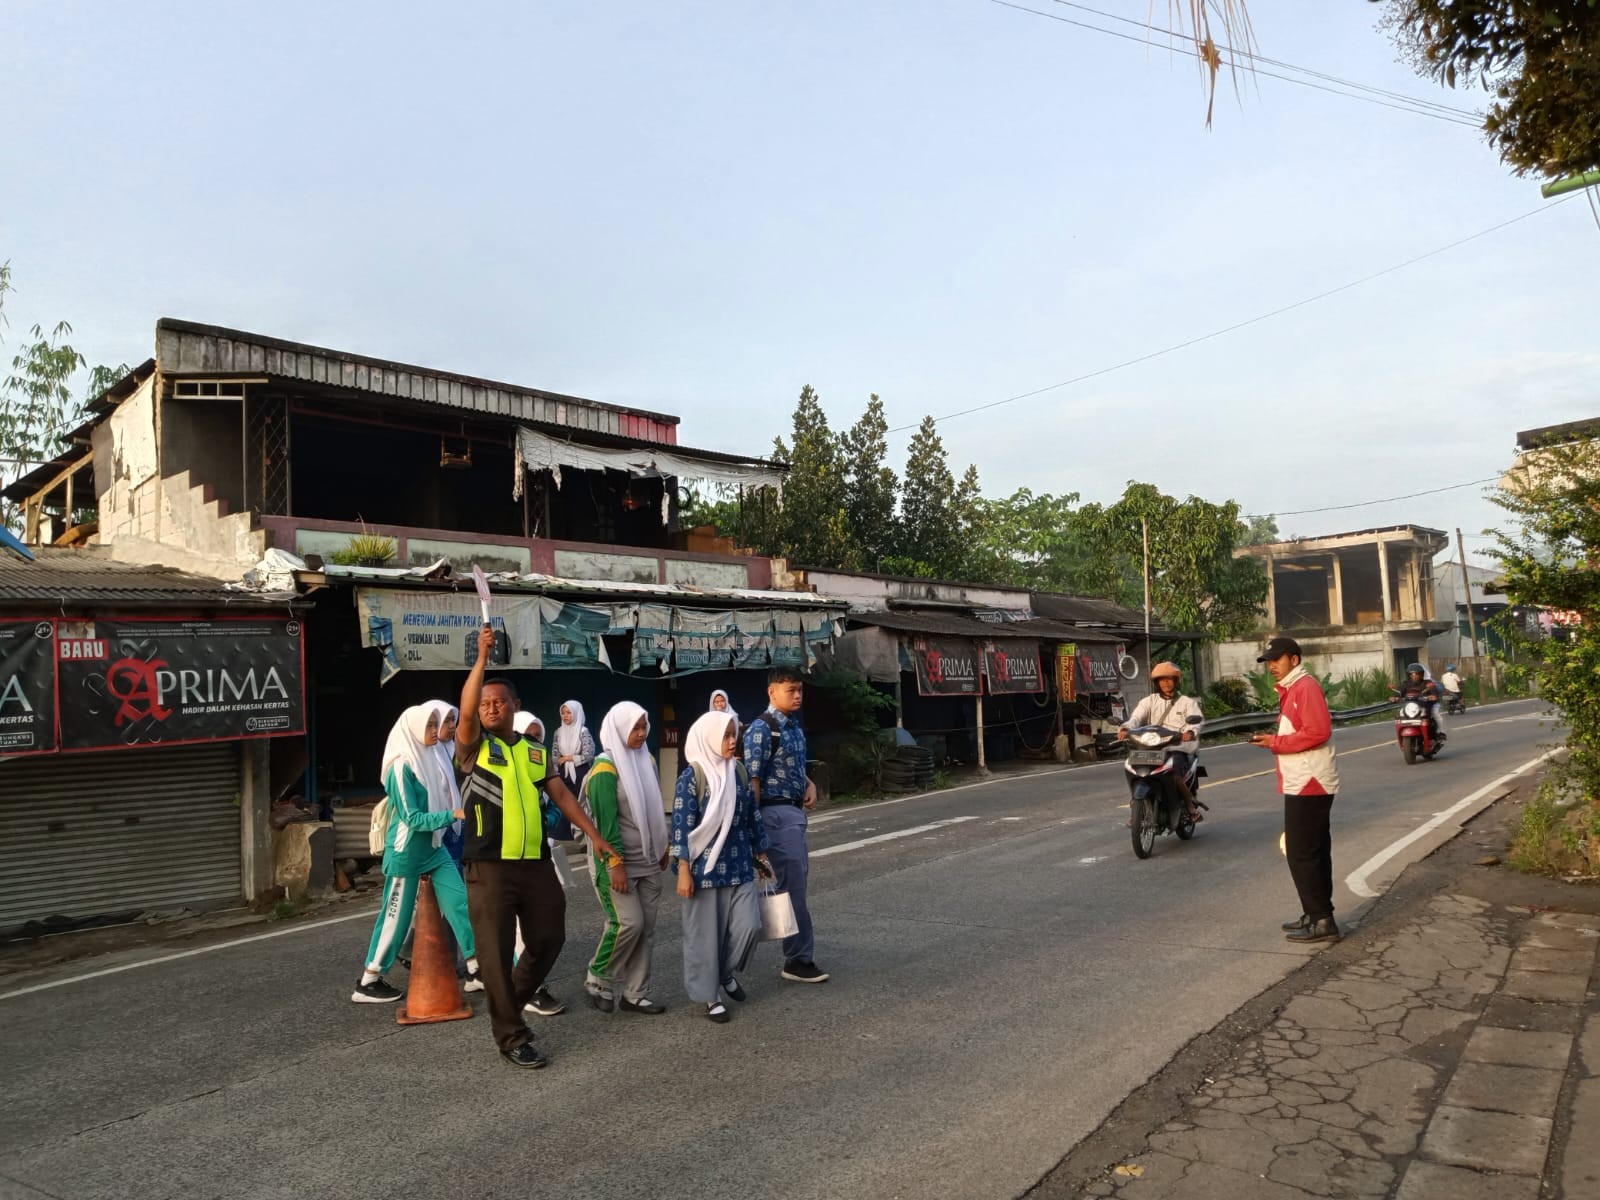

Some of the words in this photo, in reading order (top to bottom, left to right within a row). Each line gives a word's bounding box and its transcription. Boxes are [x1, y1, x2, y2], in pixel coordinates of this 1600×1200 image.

[403, 613, 436, 626] MENERIMA
[437, 614, 462, 628] JAHITAN
[463, 615, 476, 628] PRIA
[408, 633, 433, 645] VERMAK
[60, 641, 103, 658] BARU
[939, 657, 974, 676] PRIMA
[1006, 658, 1036, 676] PRIMA
[1089, 661, 1117, 677] PRIMA
[156, 666, 288, 705] PRIMA
[206, 704, 231, 713] DALAM
[264, 702, 288, 710] KERTAS
[0, 715, 34, 724] KERTAS
